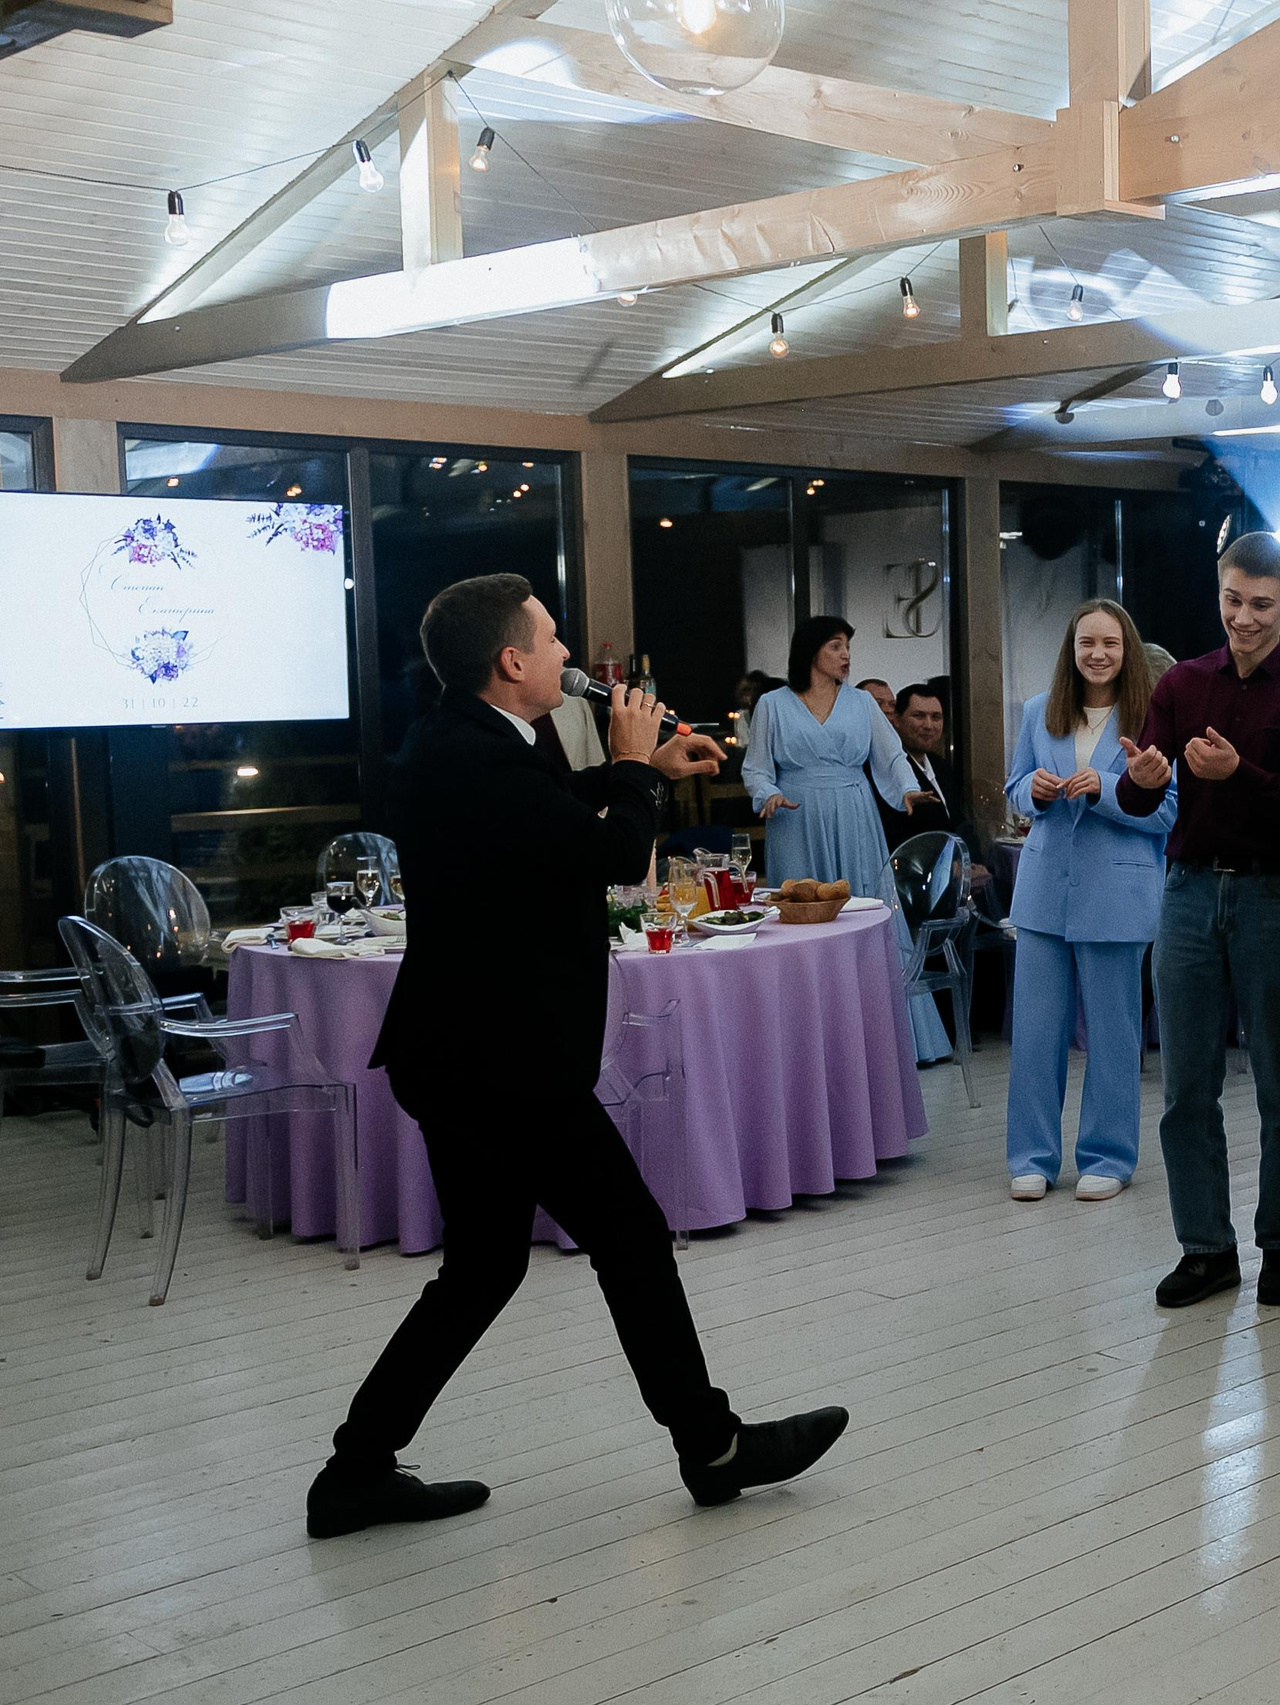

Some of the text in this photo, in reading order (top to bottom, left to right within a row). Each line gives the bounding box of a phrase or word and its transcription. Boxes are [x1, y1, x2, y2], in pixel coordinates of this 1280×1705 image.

[123, 698, 134, 709] 31
[153, 698, 165, 708] 10
[183, 697, 198, 708] 22
